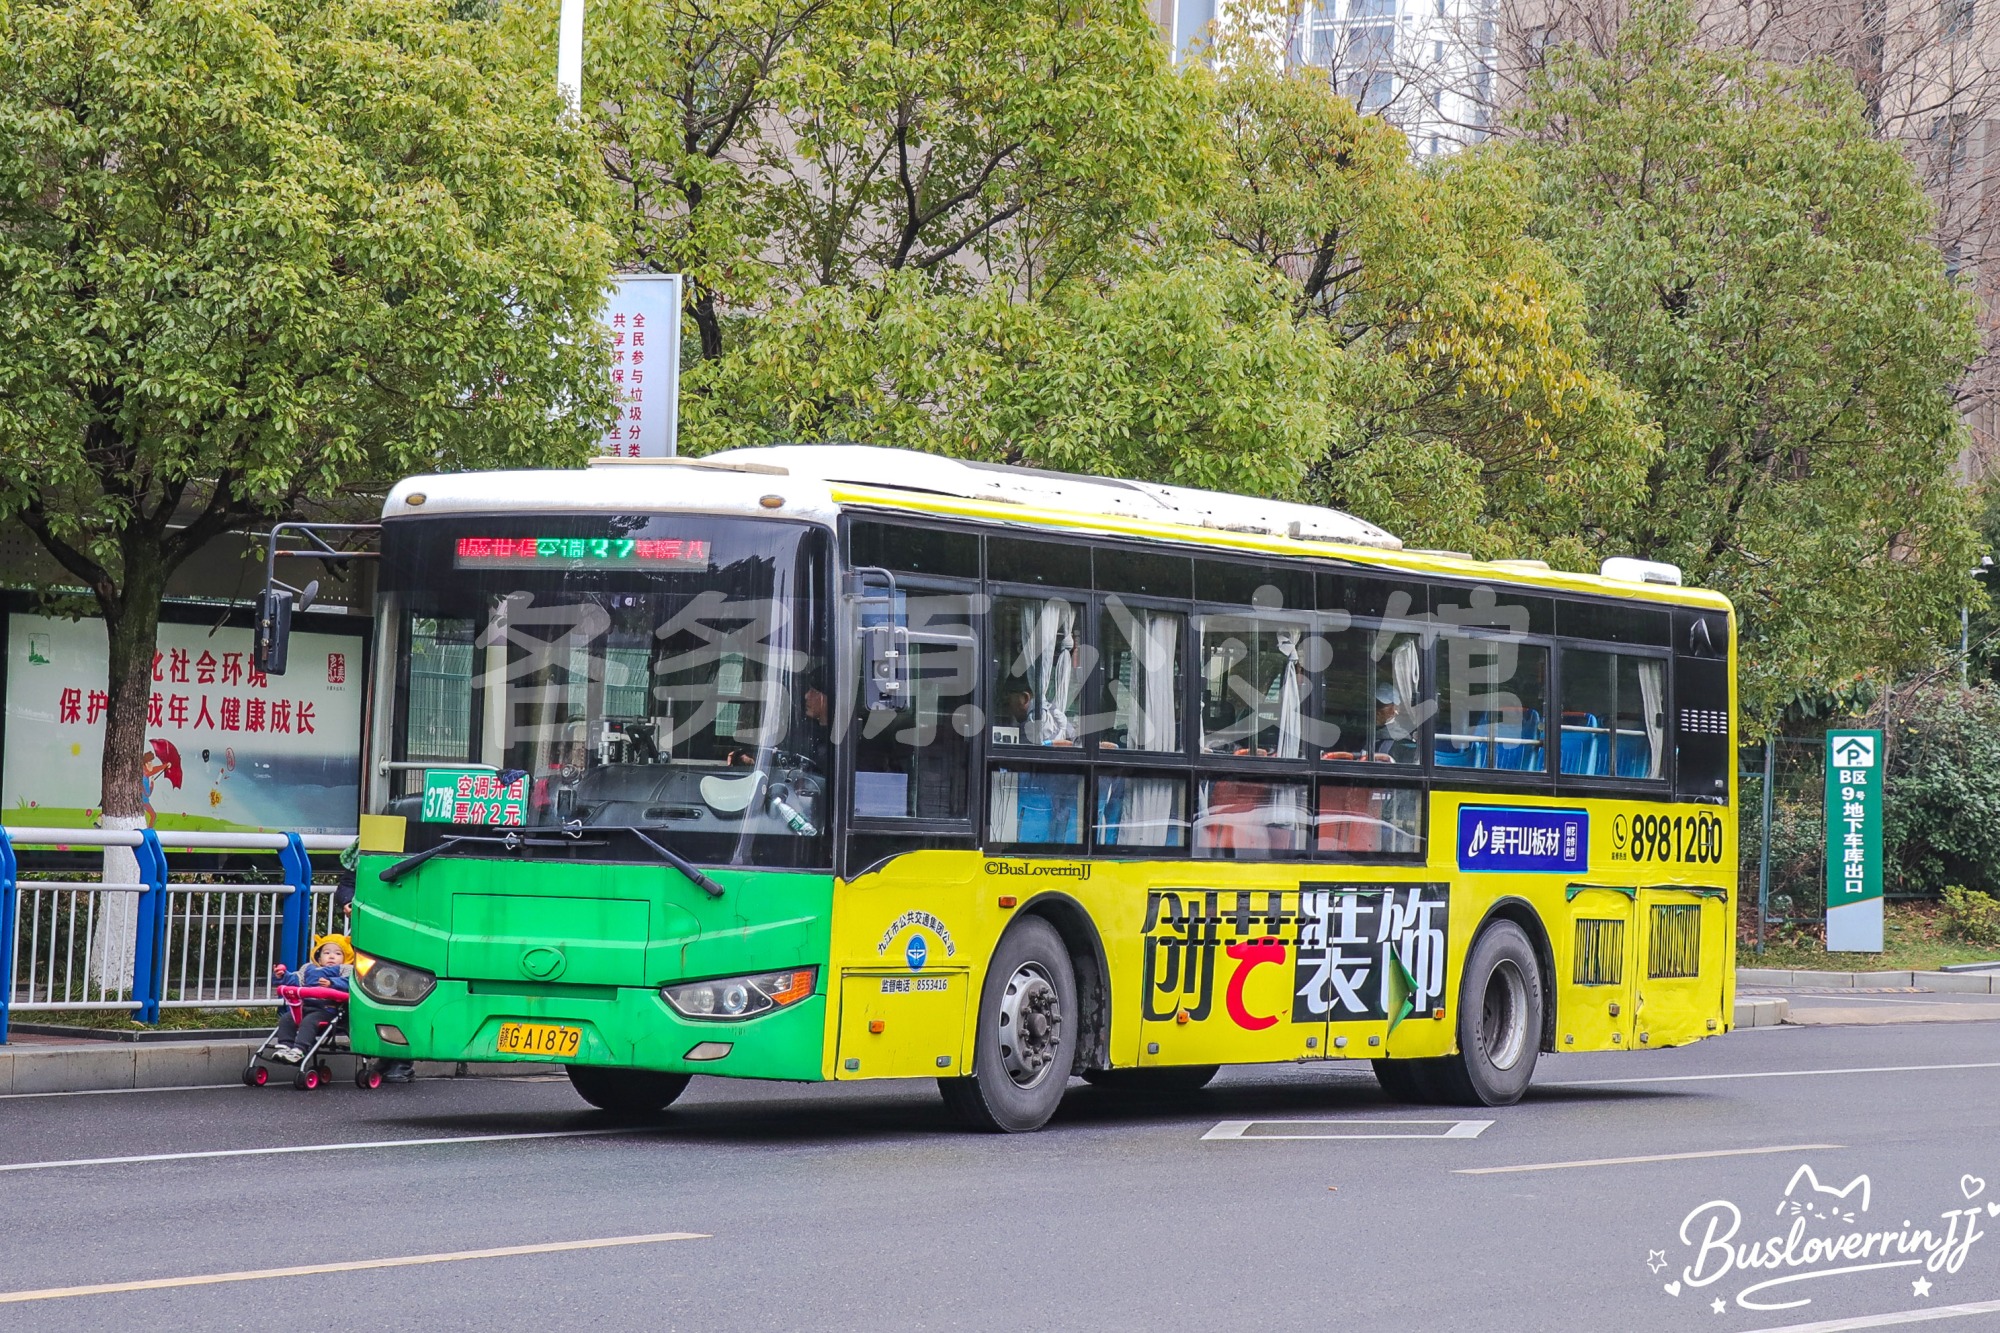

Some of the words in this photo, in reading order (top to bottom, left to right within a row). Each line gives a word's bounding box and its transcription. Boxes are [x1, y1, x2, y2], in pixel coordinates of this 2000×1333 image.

[628, 312, 645, 458] 全民参与垃圾分类
[59, 687, 316, 734] 保护成年人健康成长
[457, 776, 523, 800] 空调开启
[1840, 770, 1867, 784] B区
[426, 787, 454, 819] 37路
[1841, 787, 1865, 801] 9号
[453, 802, 520, 826] 票价2元
[1490, 826, 1560, 856] 莫干山板材
[1630, 813, 1722, 864] 8981200
[1843, 802, 1864, 893] 地下车库出口
[878, 911, 955, 957] 九江市公共交通集团公司
